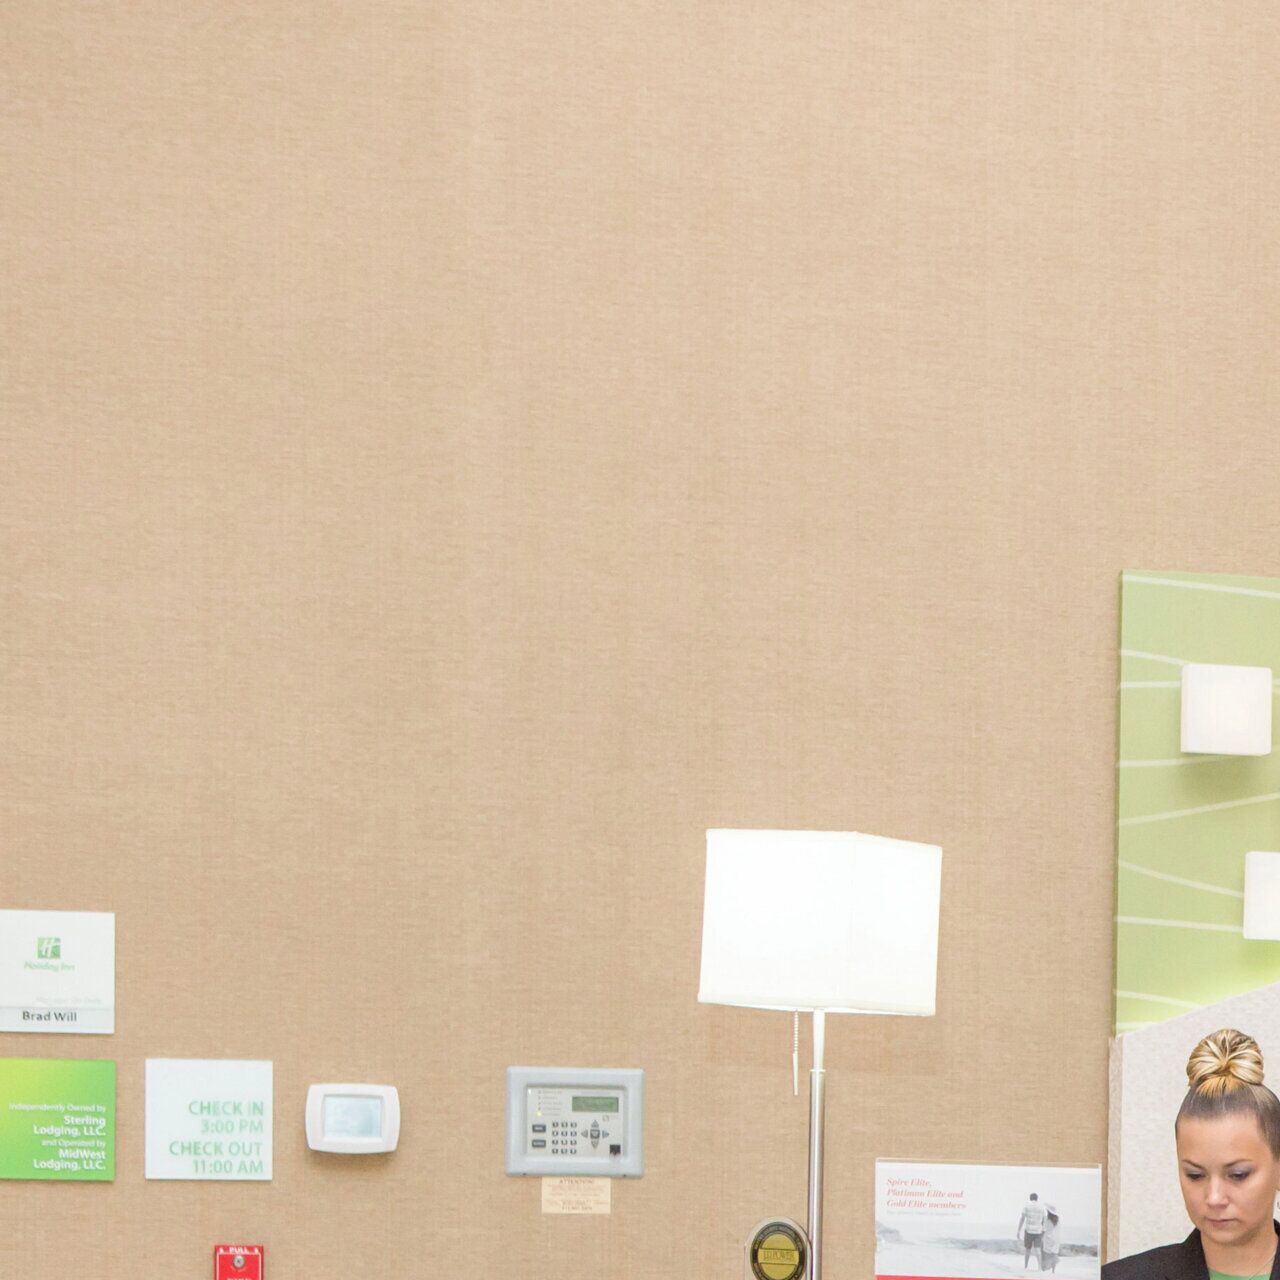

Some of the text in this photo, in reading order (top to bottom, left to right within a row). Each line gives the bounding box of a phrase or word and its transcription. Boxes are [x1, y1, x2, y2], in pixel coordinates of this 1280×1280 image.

[22, 1010, 78, 1022] Brad Will
[187, 1100, 264, 1117] CHECK IN
[63, 1115, 106, 1129] Sterling
[201, 1119, 264, 1134] 3:00 PM
[33, 1124, 82, 1137] Lodging,
[57, 1148, 106, 1160] MidWest
[168, 1140, 263, 1156] CHECK OUT
[193, 1159, 264, 1175] 11:00 AM
[887, 1176, 908, 1188] Spire
[887, 1188, 965, 1199] Platinum Elite and
[886, 1199, 968, 1210] Gold Elite members
[228, 1246, 250, 1254] PULL
